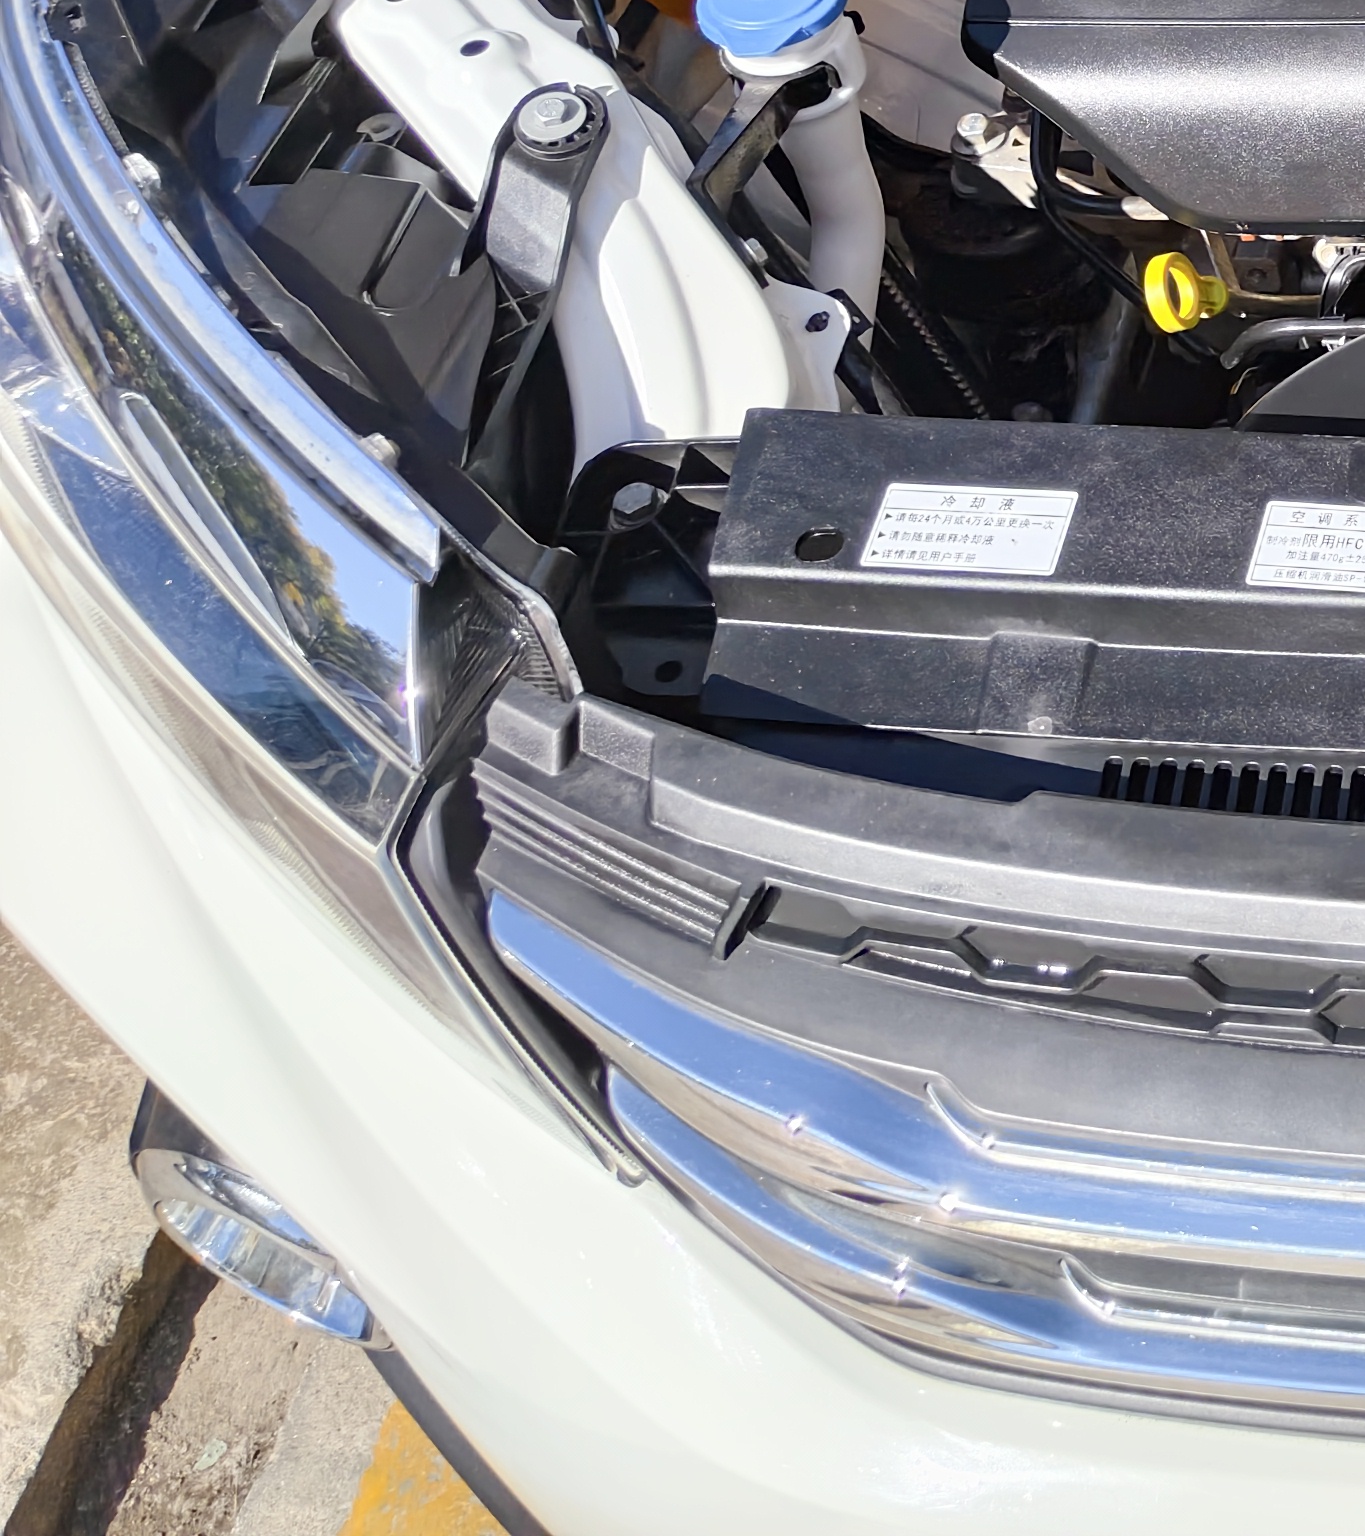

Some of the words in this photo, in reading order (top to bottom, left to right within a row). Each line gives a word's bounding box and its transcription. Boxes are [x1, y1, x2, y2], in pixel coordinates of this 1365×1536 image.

[940, 494, 1016, 512] 冷却液
[894, 511, 1055, 530] 请每24个月或4万公里更换一次
[888, 530, 995, 546] 请勿随意稀释冷却液
[881, 548, 977, 564] 详情请见用户手册
